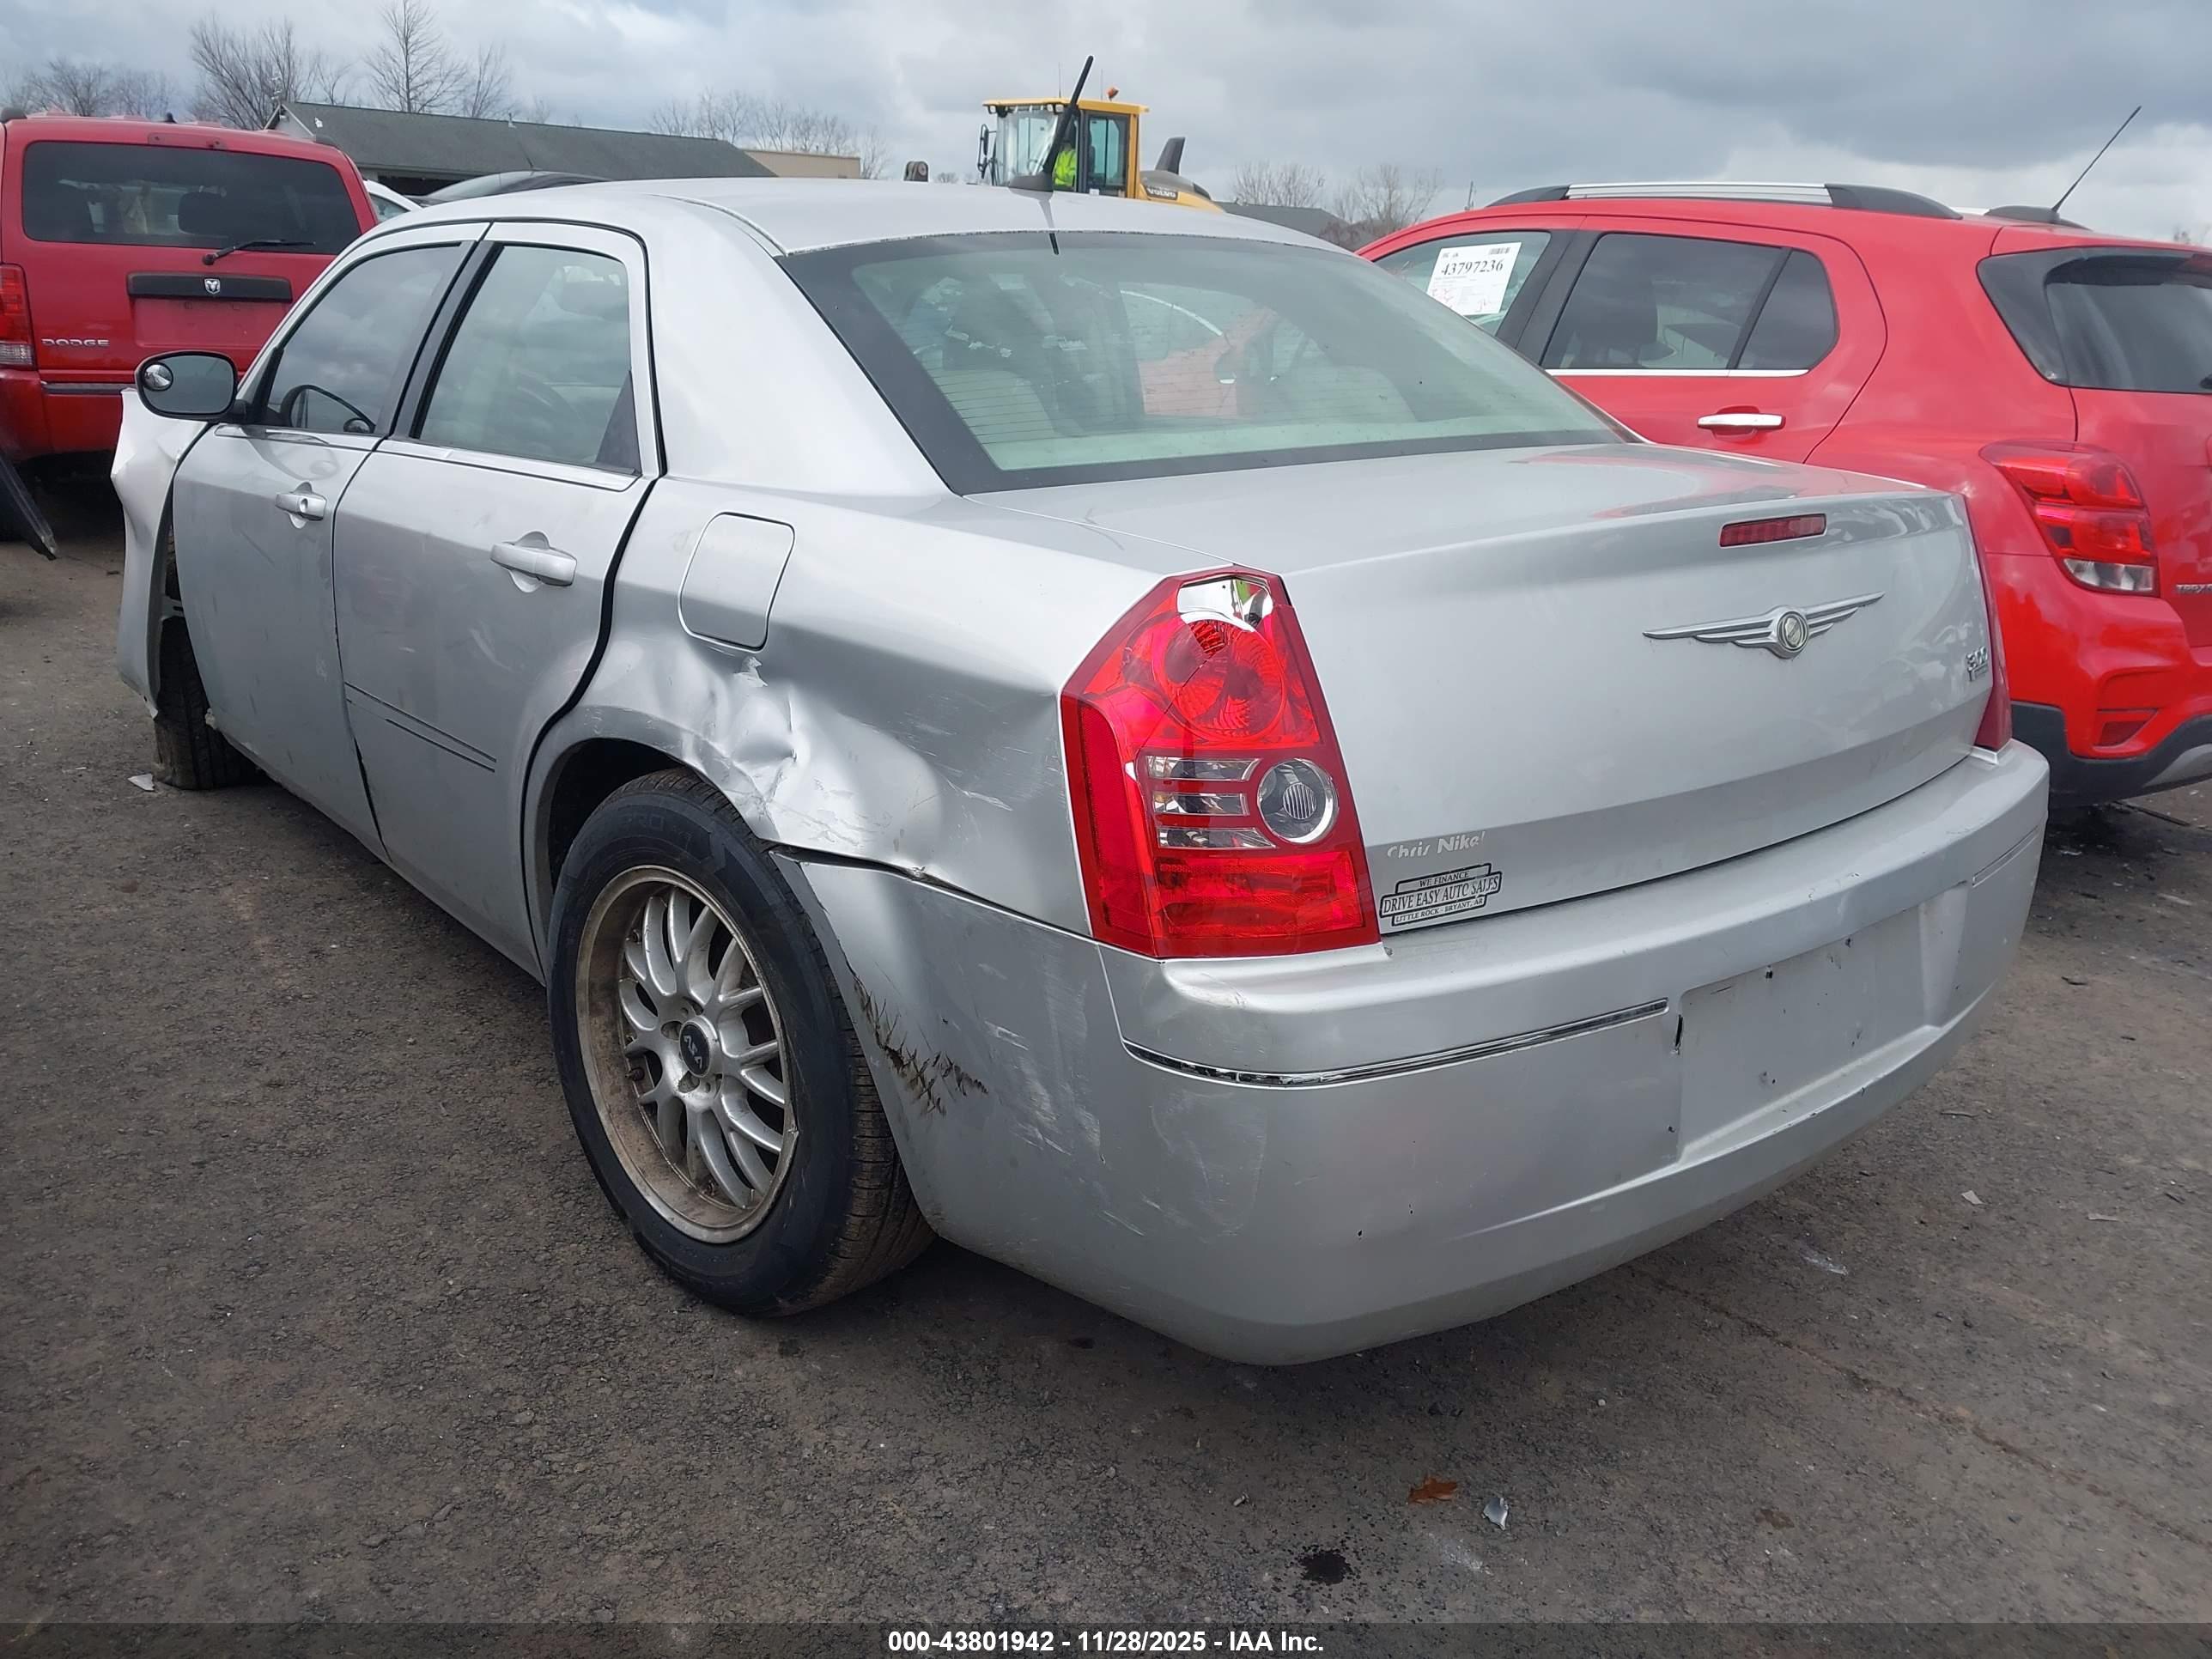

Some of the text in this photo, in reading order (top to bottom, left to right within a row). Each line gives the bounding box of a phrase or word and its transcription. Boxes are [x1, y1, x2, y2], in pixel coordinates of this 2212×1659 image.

[1442, 259, 1504, 275] 43797236
[41, 338, 110, 347] DODGE
[1387, 842, 1431, 859] Chris
[1419, 871, 1469, 887] WE FINANCE
[1383, 875, 1498, 914] DRIVE EASY AUTO SALES
[1395, 911, 1419, 922] LITTLE
[1421, 908, 1439, 917] ROCK
